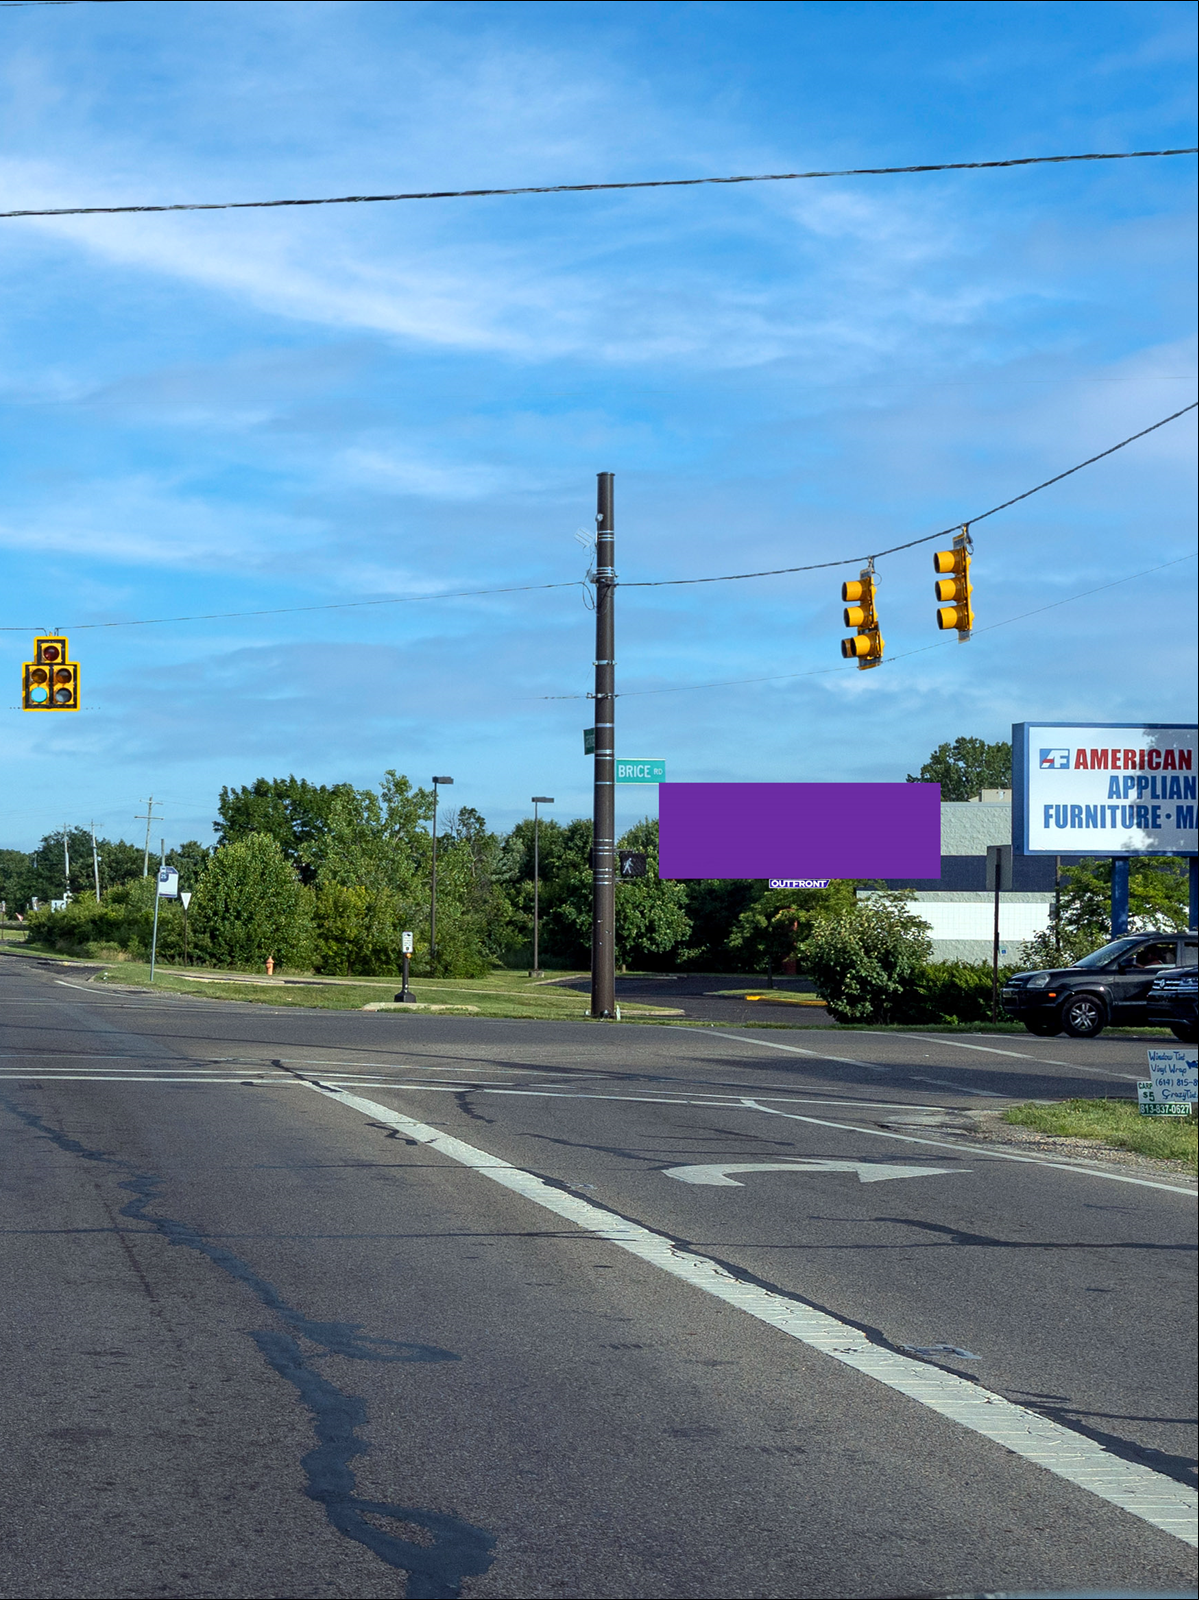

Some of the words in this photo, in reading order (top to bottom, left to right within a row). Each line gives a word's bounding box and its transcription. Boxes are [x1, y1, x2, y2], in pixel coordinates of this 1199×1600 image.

[1074, 748, 1192, 770] AMERICAN
[618, 764, 651, 778] BRICE
[1107, 775, 1197, 800] APPLIAN
[1043, 804, 1162, 829] FURNITURE
[770, 879, 827, 888] OUTFRONT
[1168, 1064, 1187, 1077] Wrap
[1155, 1078, 1174, 1087] (614)
[1176, 1078, 1198, 1087] 815-8
